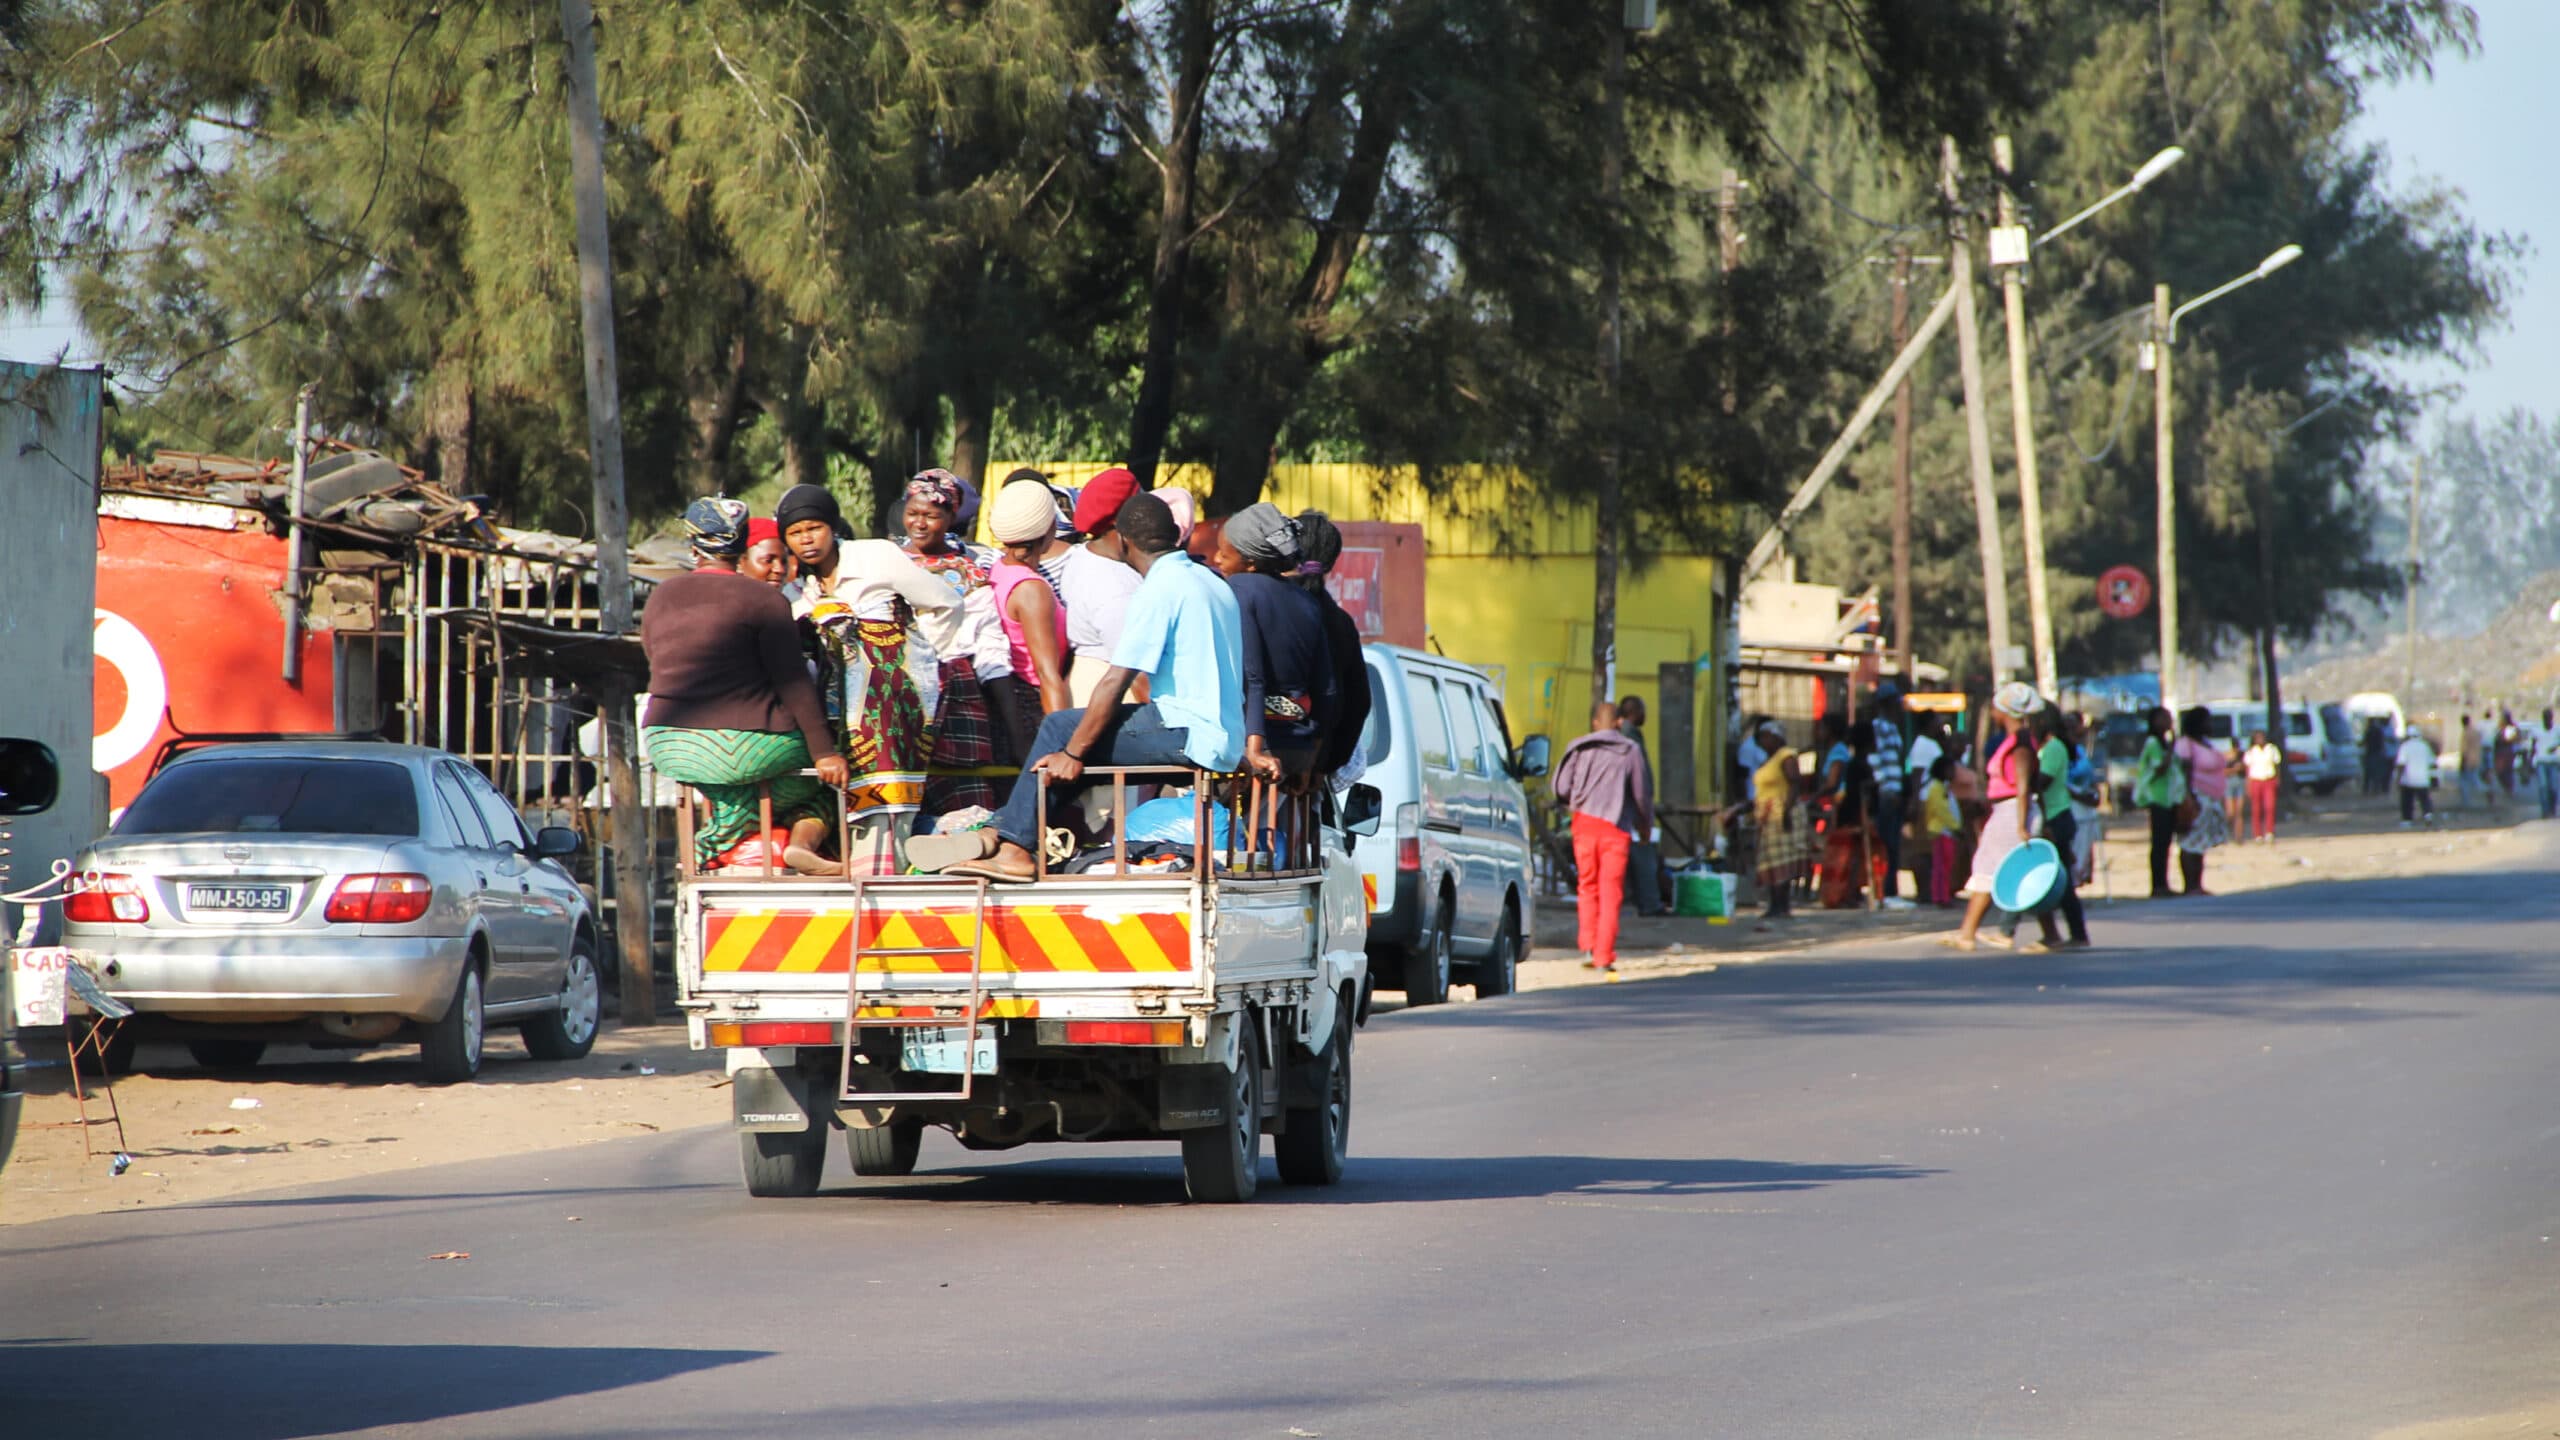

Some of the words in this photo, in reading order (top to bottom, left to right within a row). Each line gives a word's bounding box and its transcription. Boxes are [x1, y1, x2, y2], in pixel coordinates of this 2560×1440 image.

[191, 889, 282, 908] MMJ-50-95
[741, 1113, 776, 1122] TOWN
[777, 1113, 801, 1122] ACE
